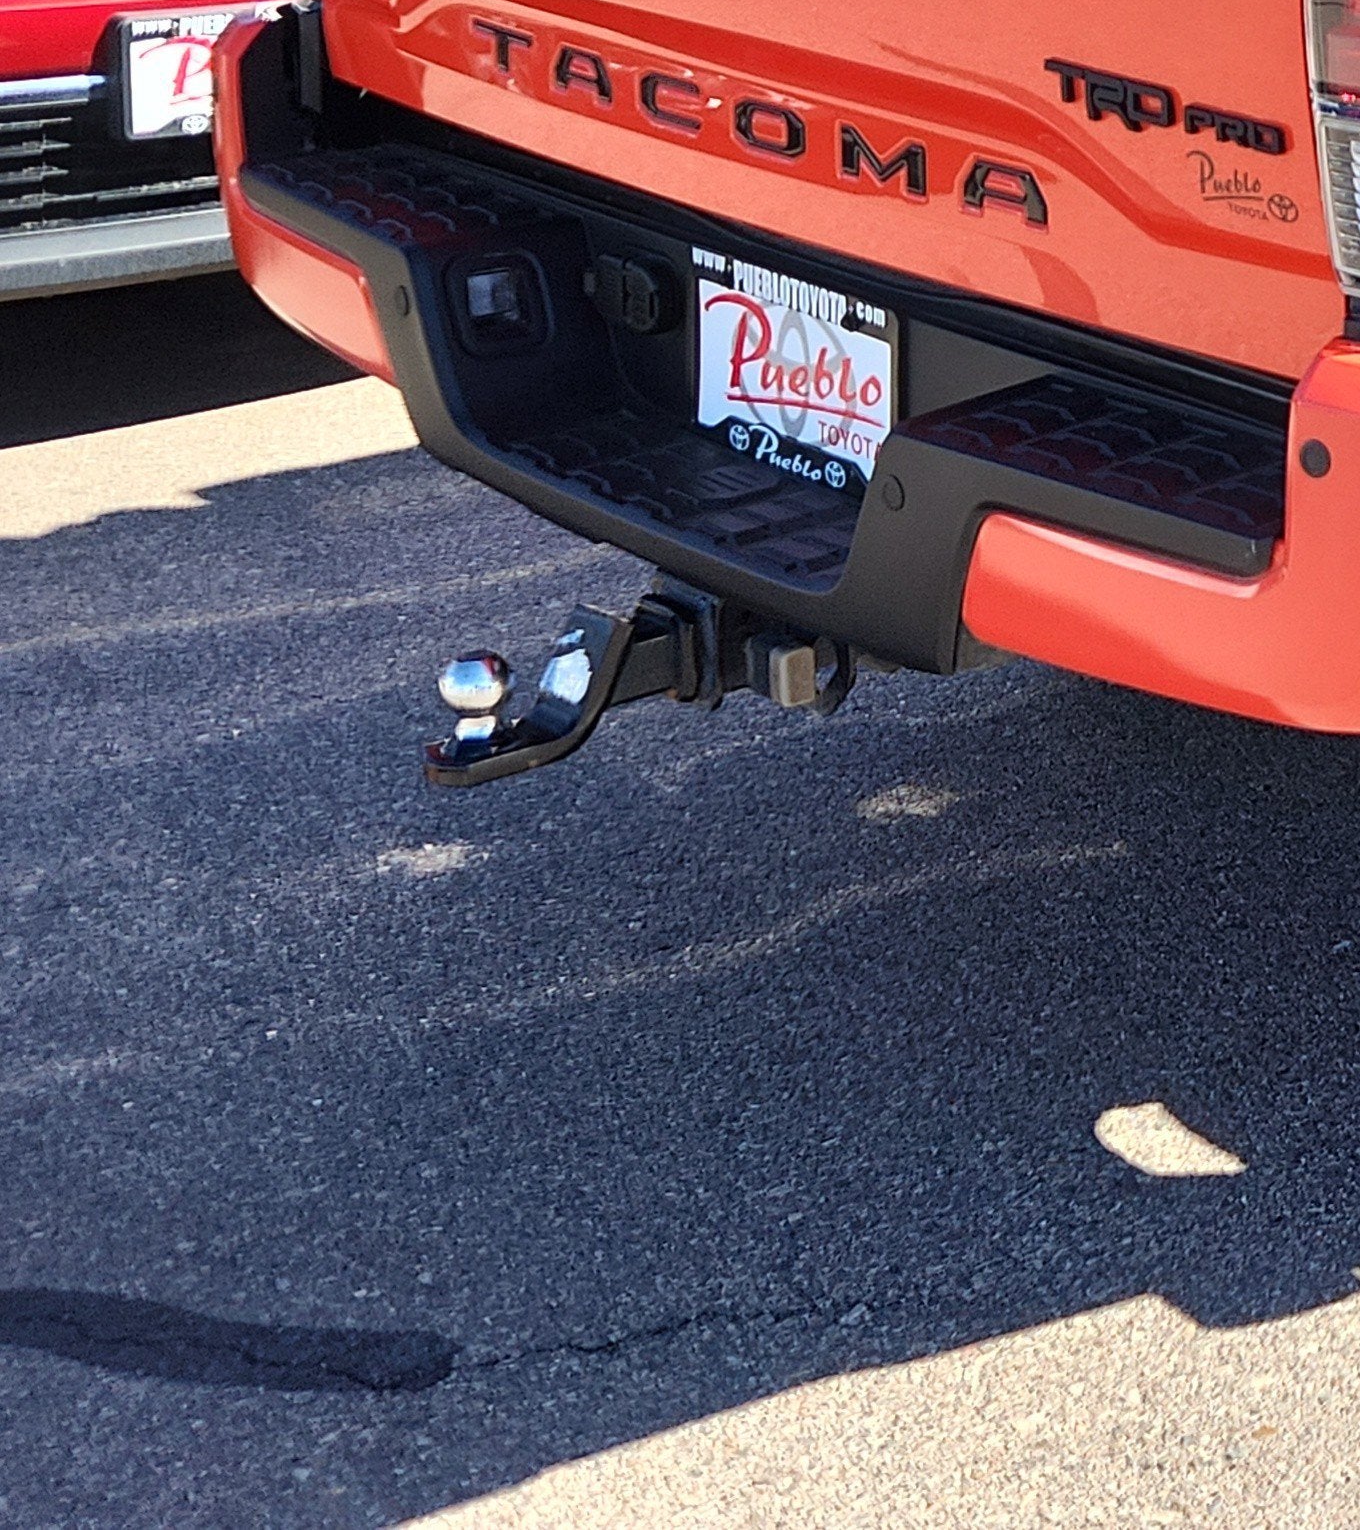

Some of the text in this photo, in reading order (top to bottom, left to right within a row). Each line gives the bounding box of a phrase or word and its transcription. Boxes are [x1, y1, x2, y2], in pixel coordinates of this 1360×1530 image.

[471, 16, 1048, 228] TACOMA
[1044, 57, 1289, 156] TRD PRO
[1186, 150, 1262, 194] Pueblo
[704, 292, 882, 407] Pueblo
[748, 424, 822, 481] Pueblo
